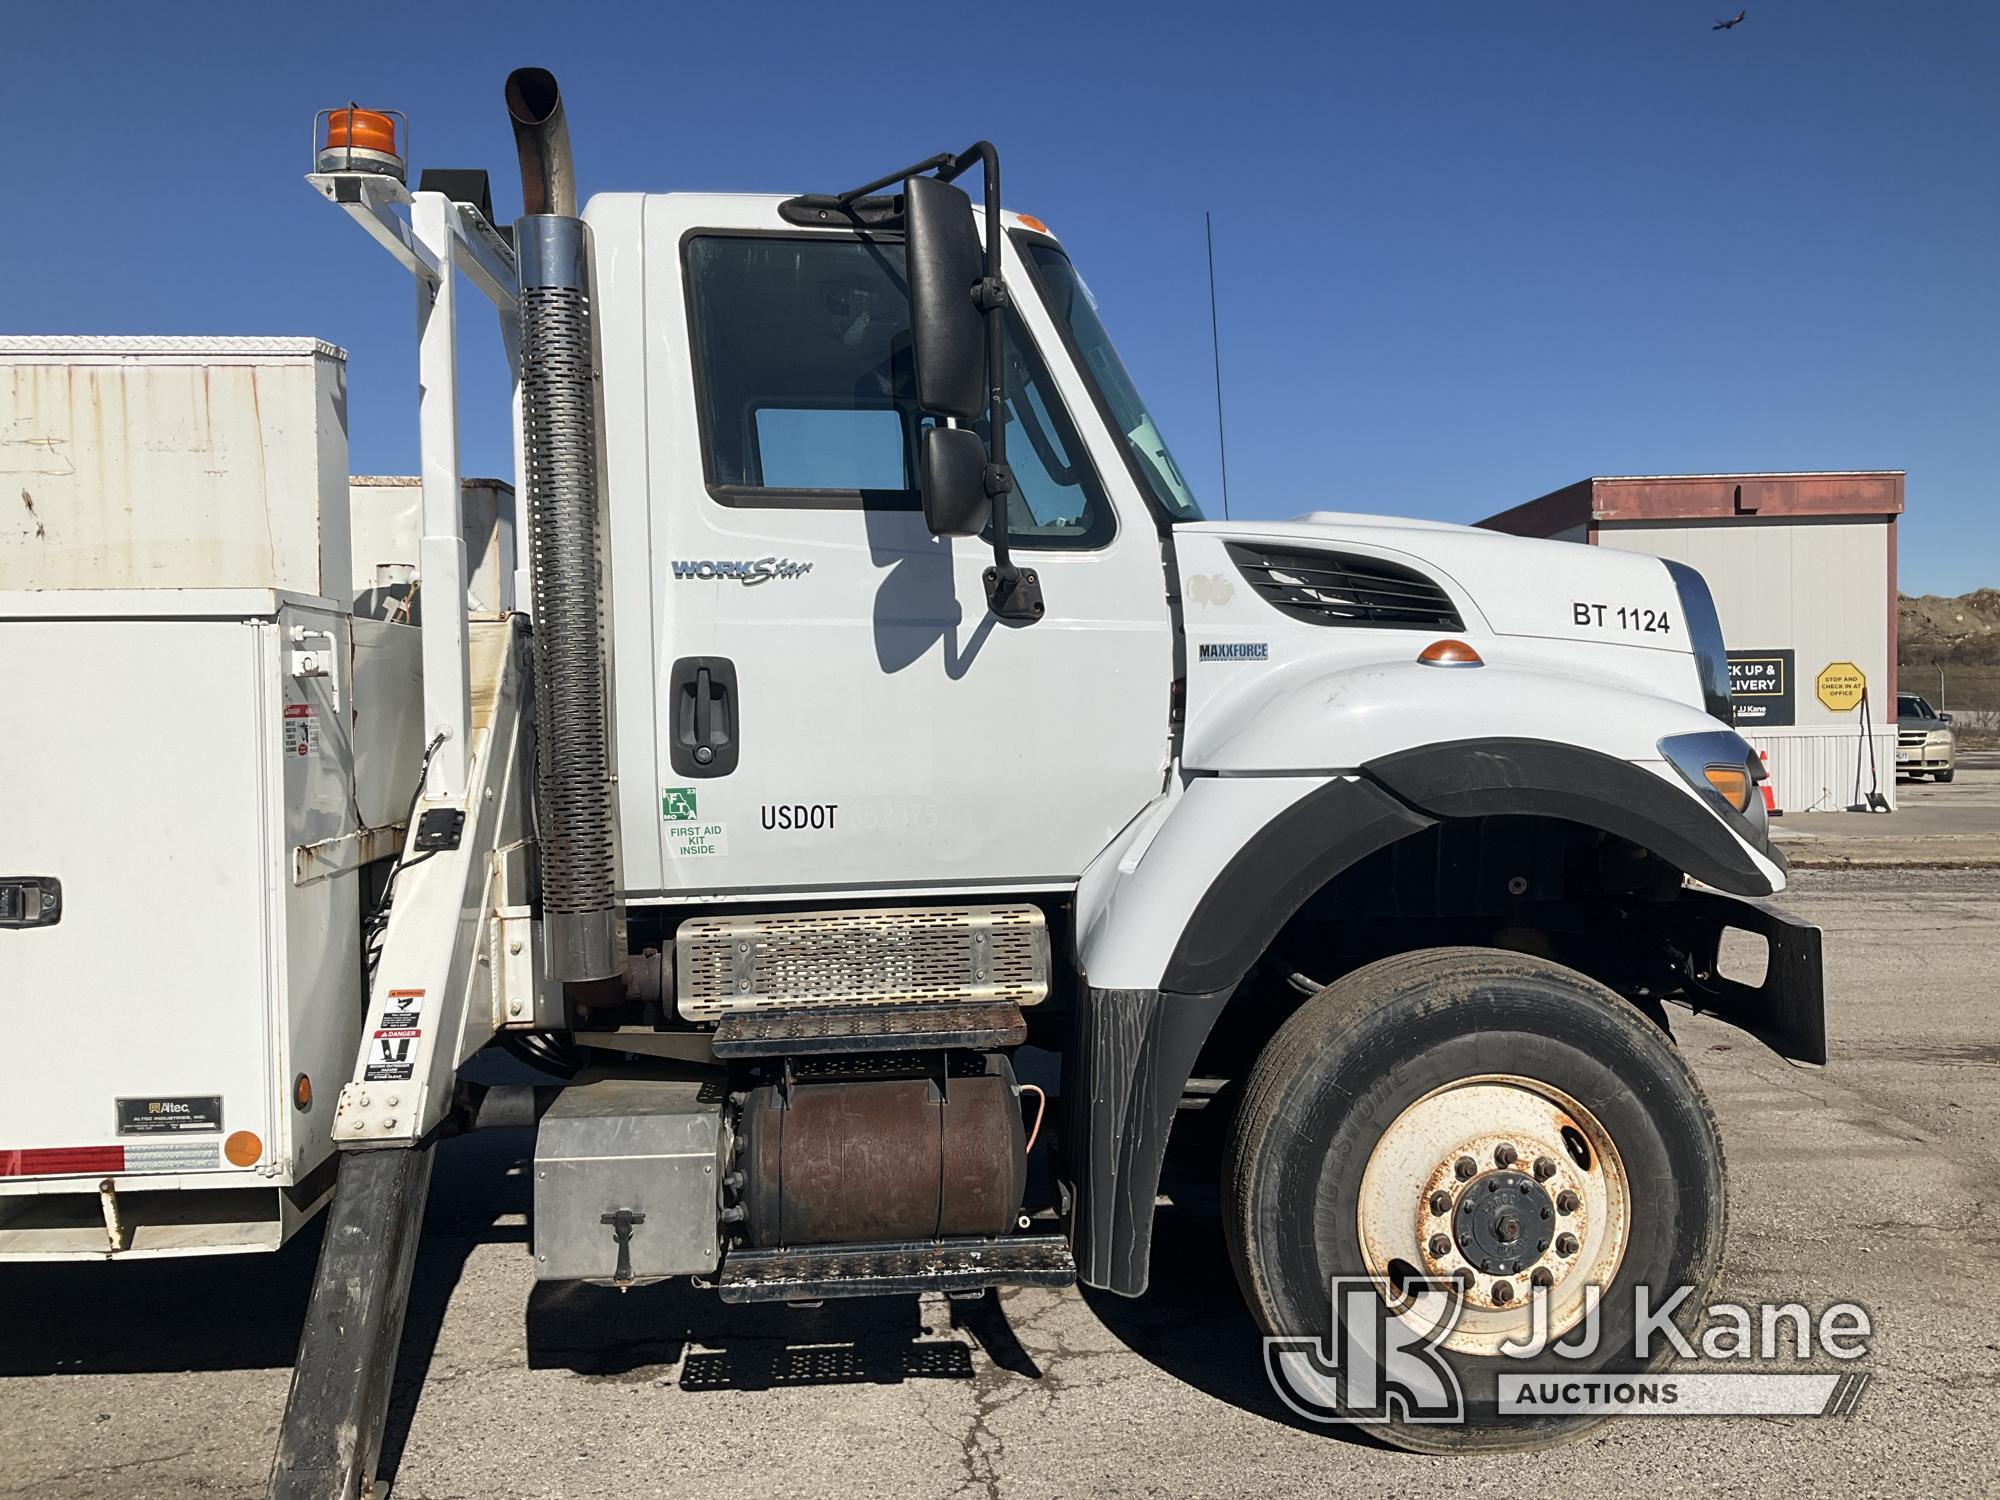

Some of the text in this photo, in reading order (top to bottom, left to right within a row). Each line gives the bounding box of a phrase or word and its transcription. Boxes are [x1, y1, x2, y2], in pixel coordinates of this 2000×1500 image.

[1573, 602, 1670, 634] BT 1124
[1199, 644, 1268, 657] MAXXFORCE
[1745, 665, 1763, 676] UP
[1766, 665, 1776, 676] &
[761, 804, 839, 830] USDOT
[670, 825, 722, 837] FIRST AID
[688, 836, 705, 845] KIT
[680, 845, 715, 855] INSIDE
[160, 1102, 190, 1113] Altec
